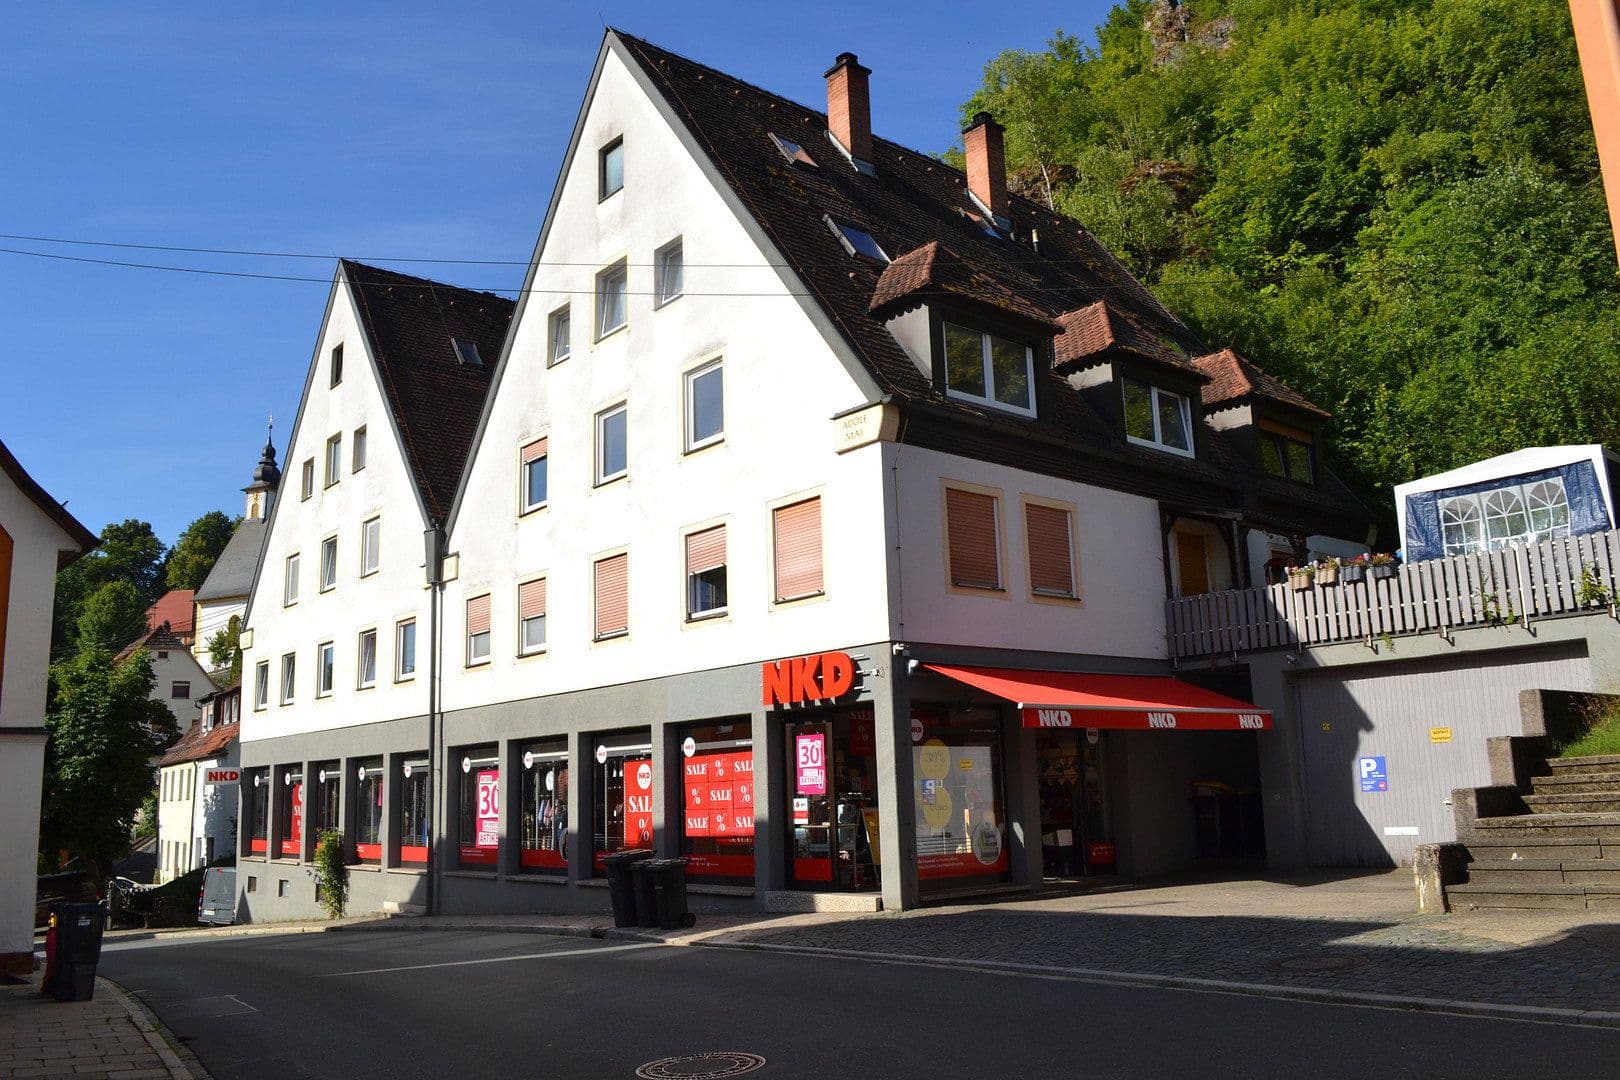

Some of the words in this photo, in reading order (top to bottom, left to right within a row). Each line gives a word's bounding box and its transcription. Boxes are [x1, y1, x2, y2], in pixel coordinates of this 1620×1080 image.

[761, 650, 854, 707] NKD
[1038, 709, 1072, 727] NKD
[1148, 712, 1177, 728] NKD
[1239, 714, 1264, 729] NKD
[800, 744, 820, 766] 30
[208, 770, 239, 782] NKD
[686, 763, 707, 775] SALE
[1360, 758, 1378, 779] P
[710, 788, 732, 801] SALE
[687, 817, 708, 829] SALE
